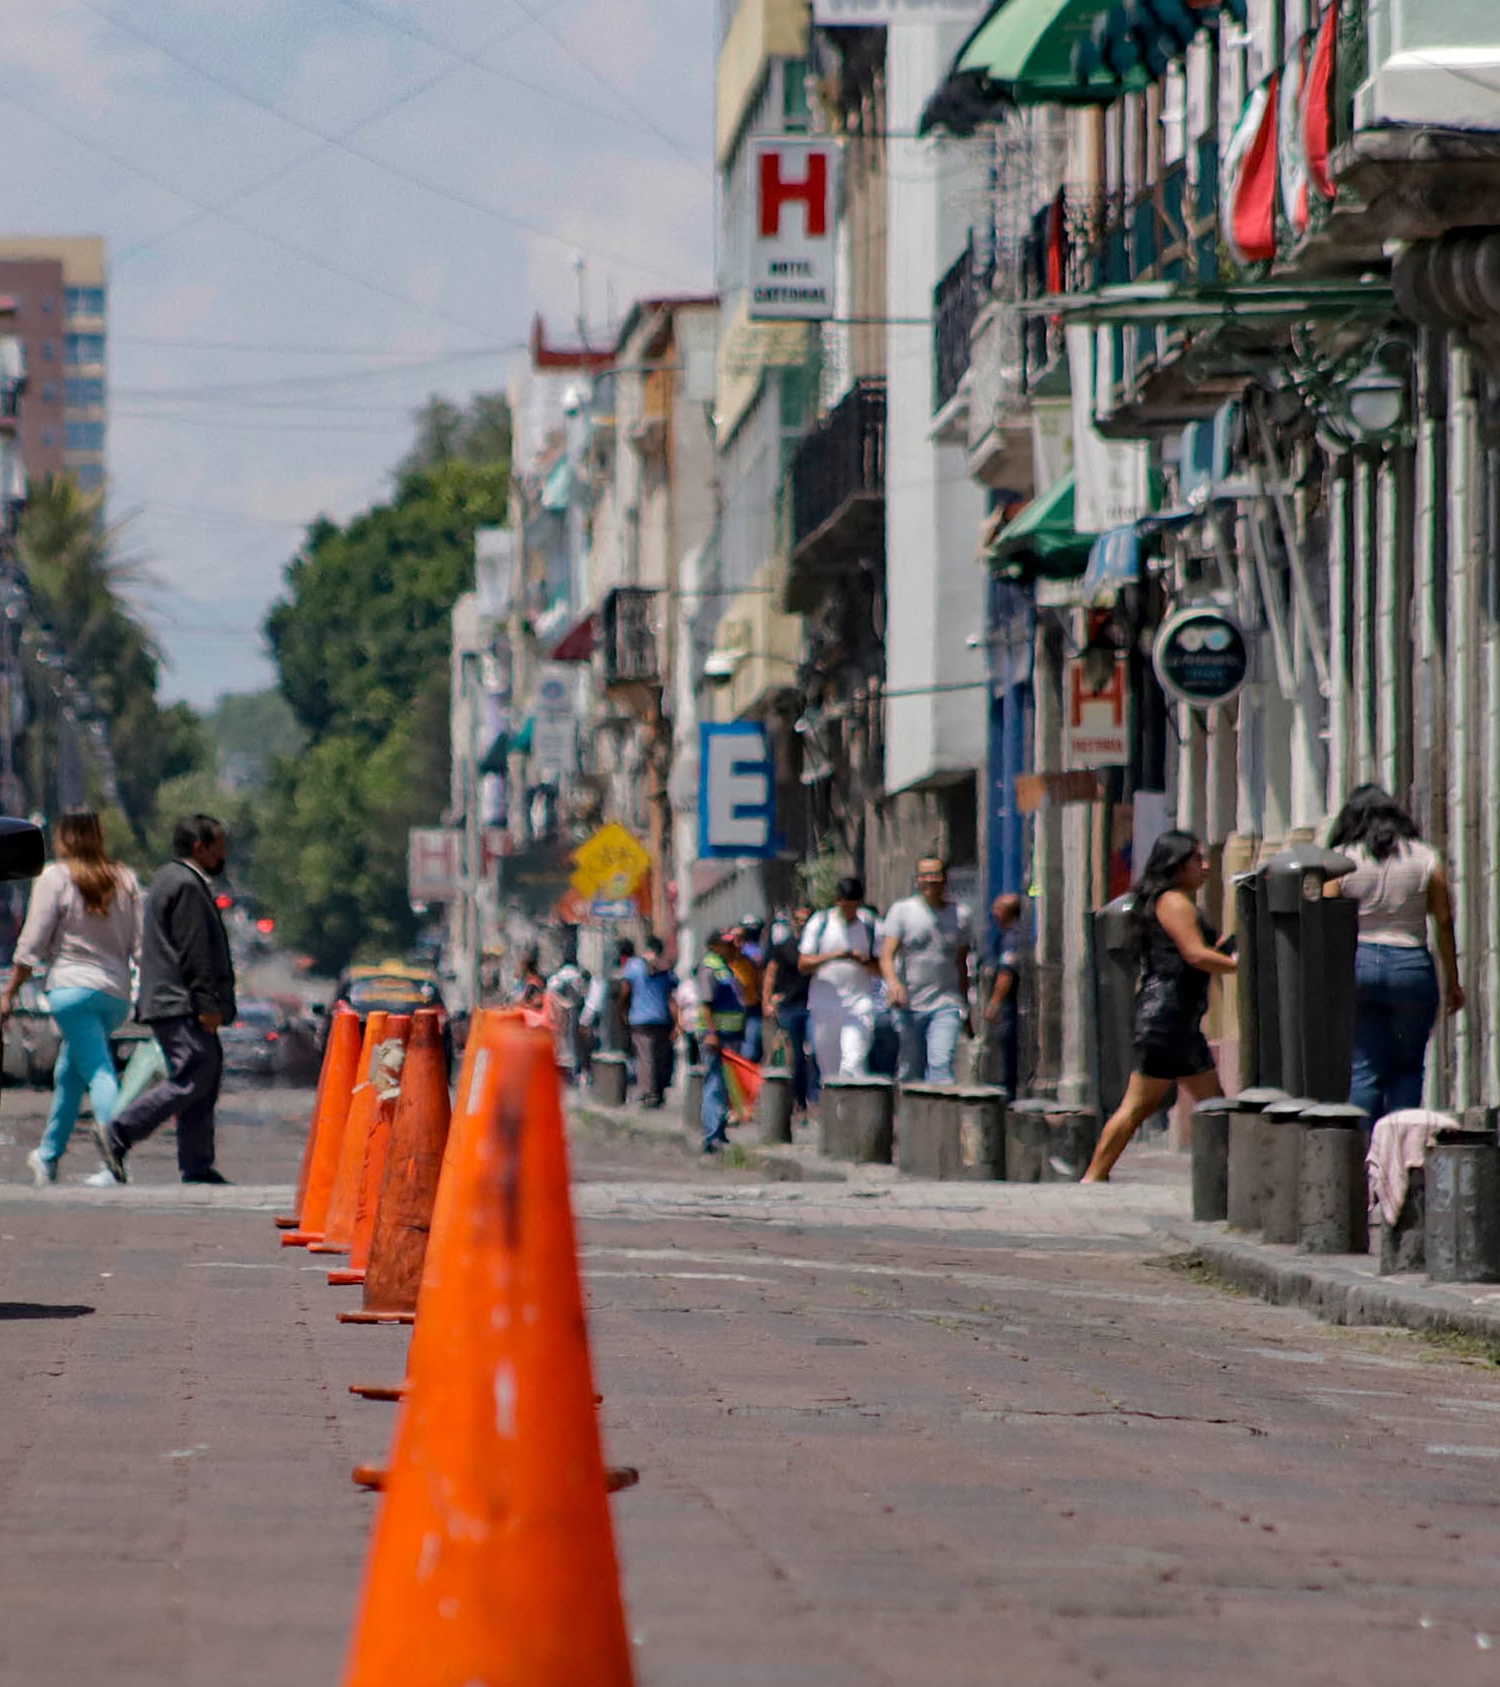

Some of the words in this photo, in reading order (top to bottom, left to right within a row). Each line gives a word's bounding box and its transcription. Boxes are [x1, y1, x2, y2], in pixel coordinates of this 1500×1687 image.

[760, 153, 827, 236] H
[1071, 665, 1123, 729] H
[707, 734, 768, 847] E
